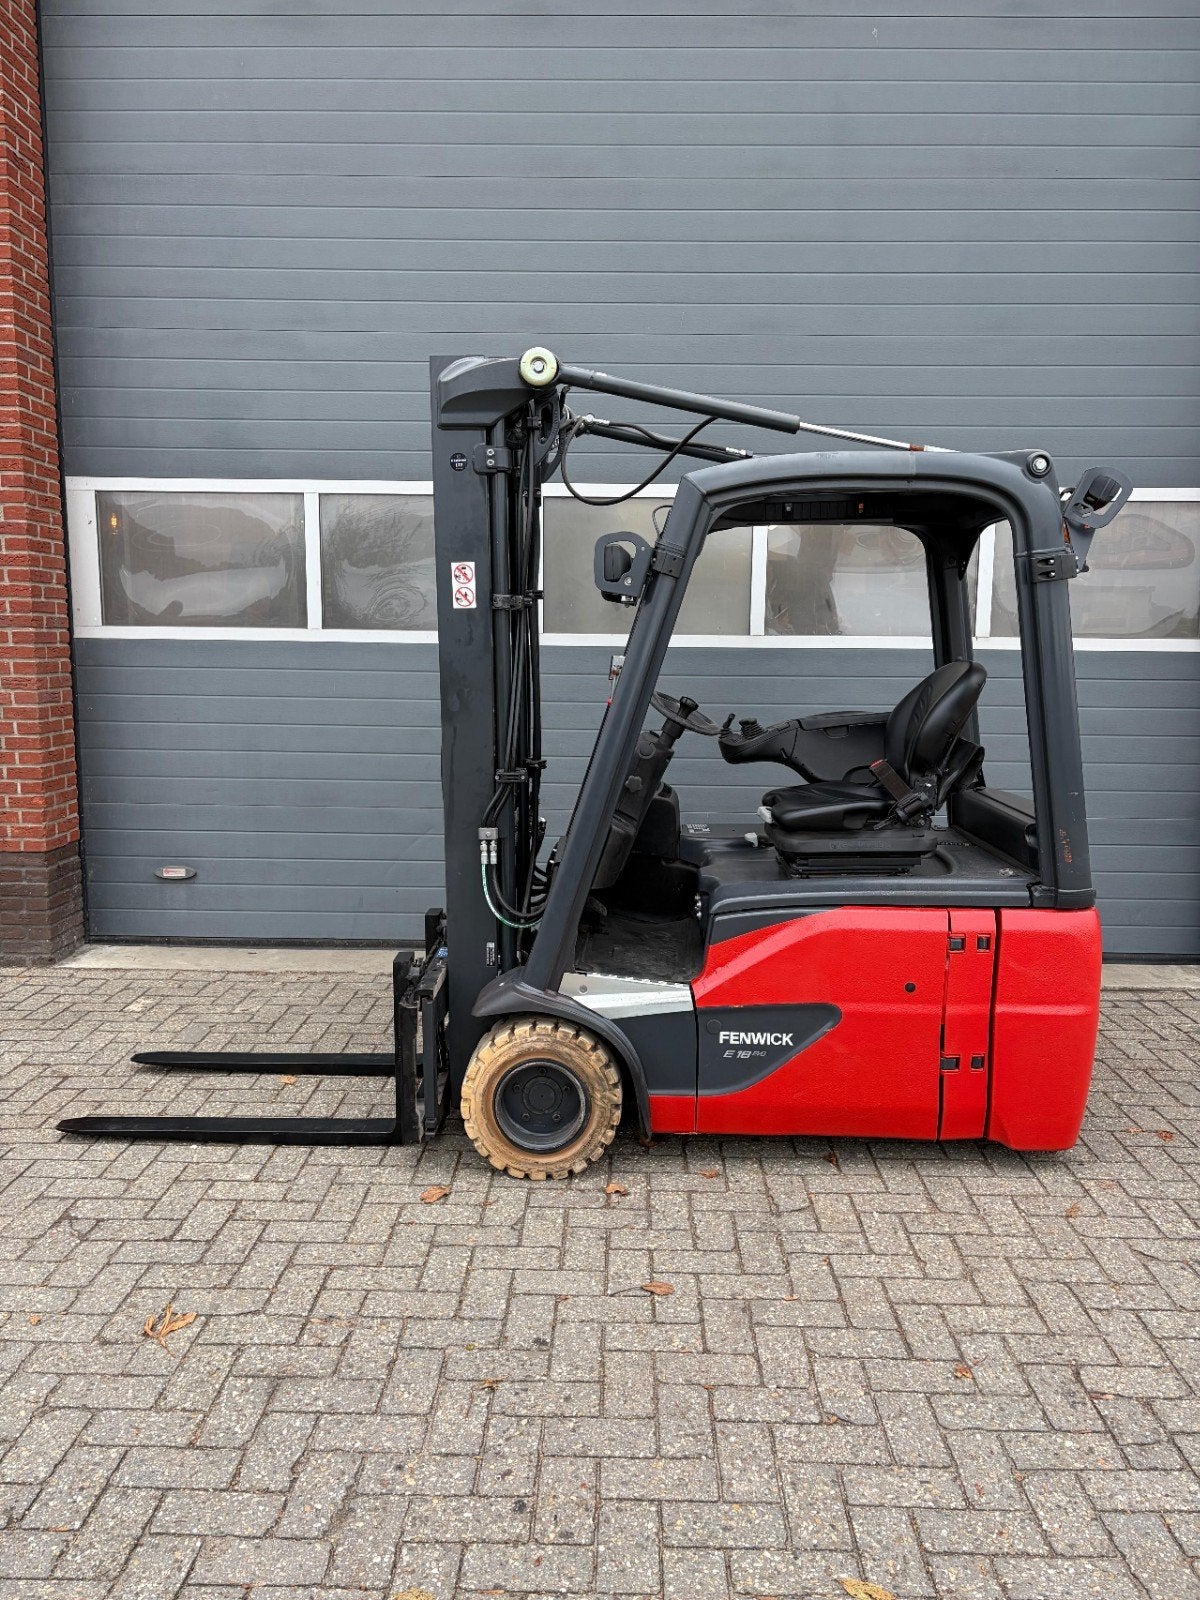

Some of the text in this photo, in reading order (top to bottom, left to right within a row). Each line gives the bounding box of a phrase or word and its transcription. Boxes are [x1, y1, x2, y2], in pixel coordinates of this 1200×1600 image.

[719, 1031, 794, 1046] FENWICK
[723, 1050, 735, 1058] E
[736, 1051, 752, 1059] 18
